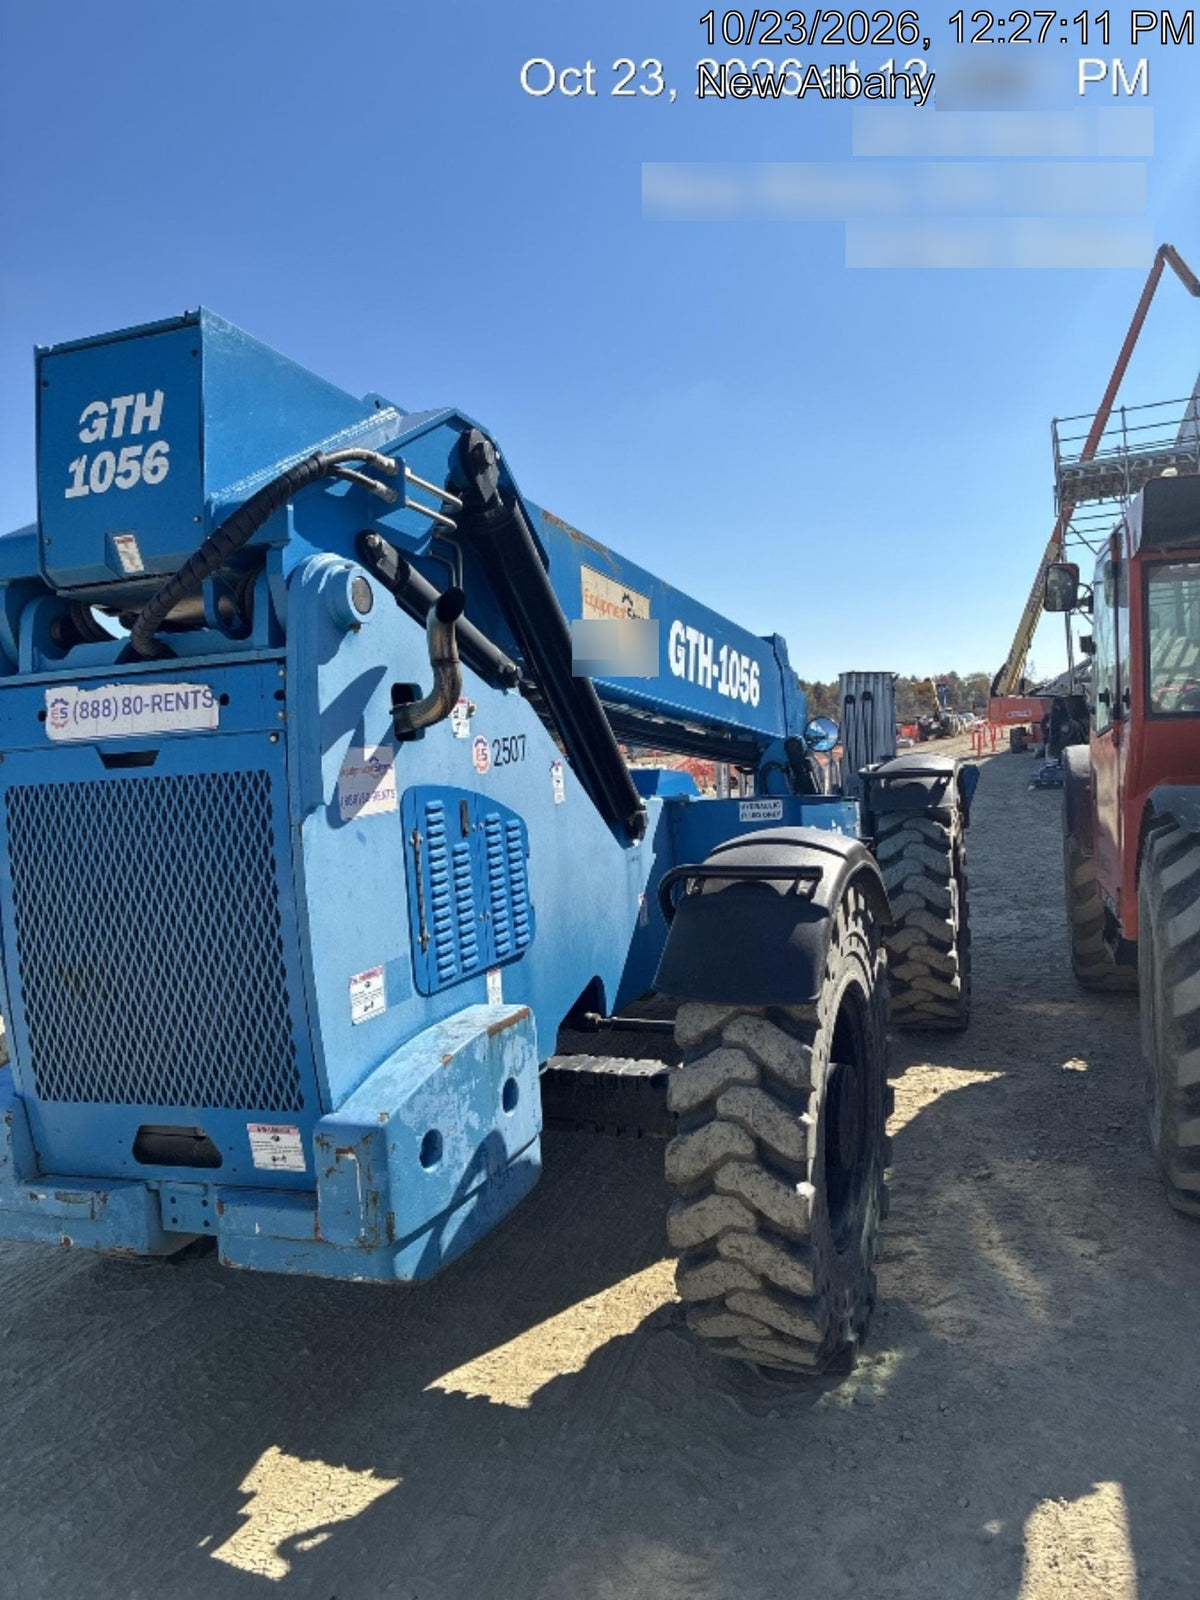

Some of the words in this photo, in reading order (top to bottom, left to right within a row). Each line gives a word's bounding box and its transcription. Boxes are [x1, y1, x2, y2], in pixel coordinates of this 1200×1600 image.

[65, 440, 170, 498] 1056
[668, 620, 760, 708] GTH-1056
[121, 689, 214, 716] 80-RENTS
[492, 734, 527, 767] 2507
